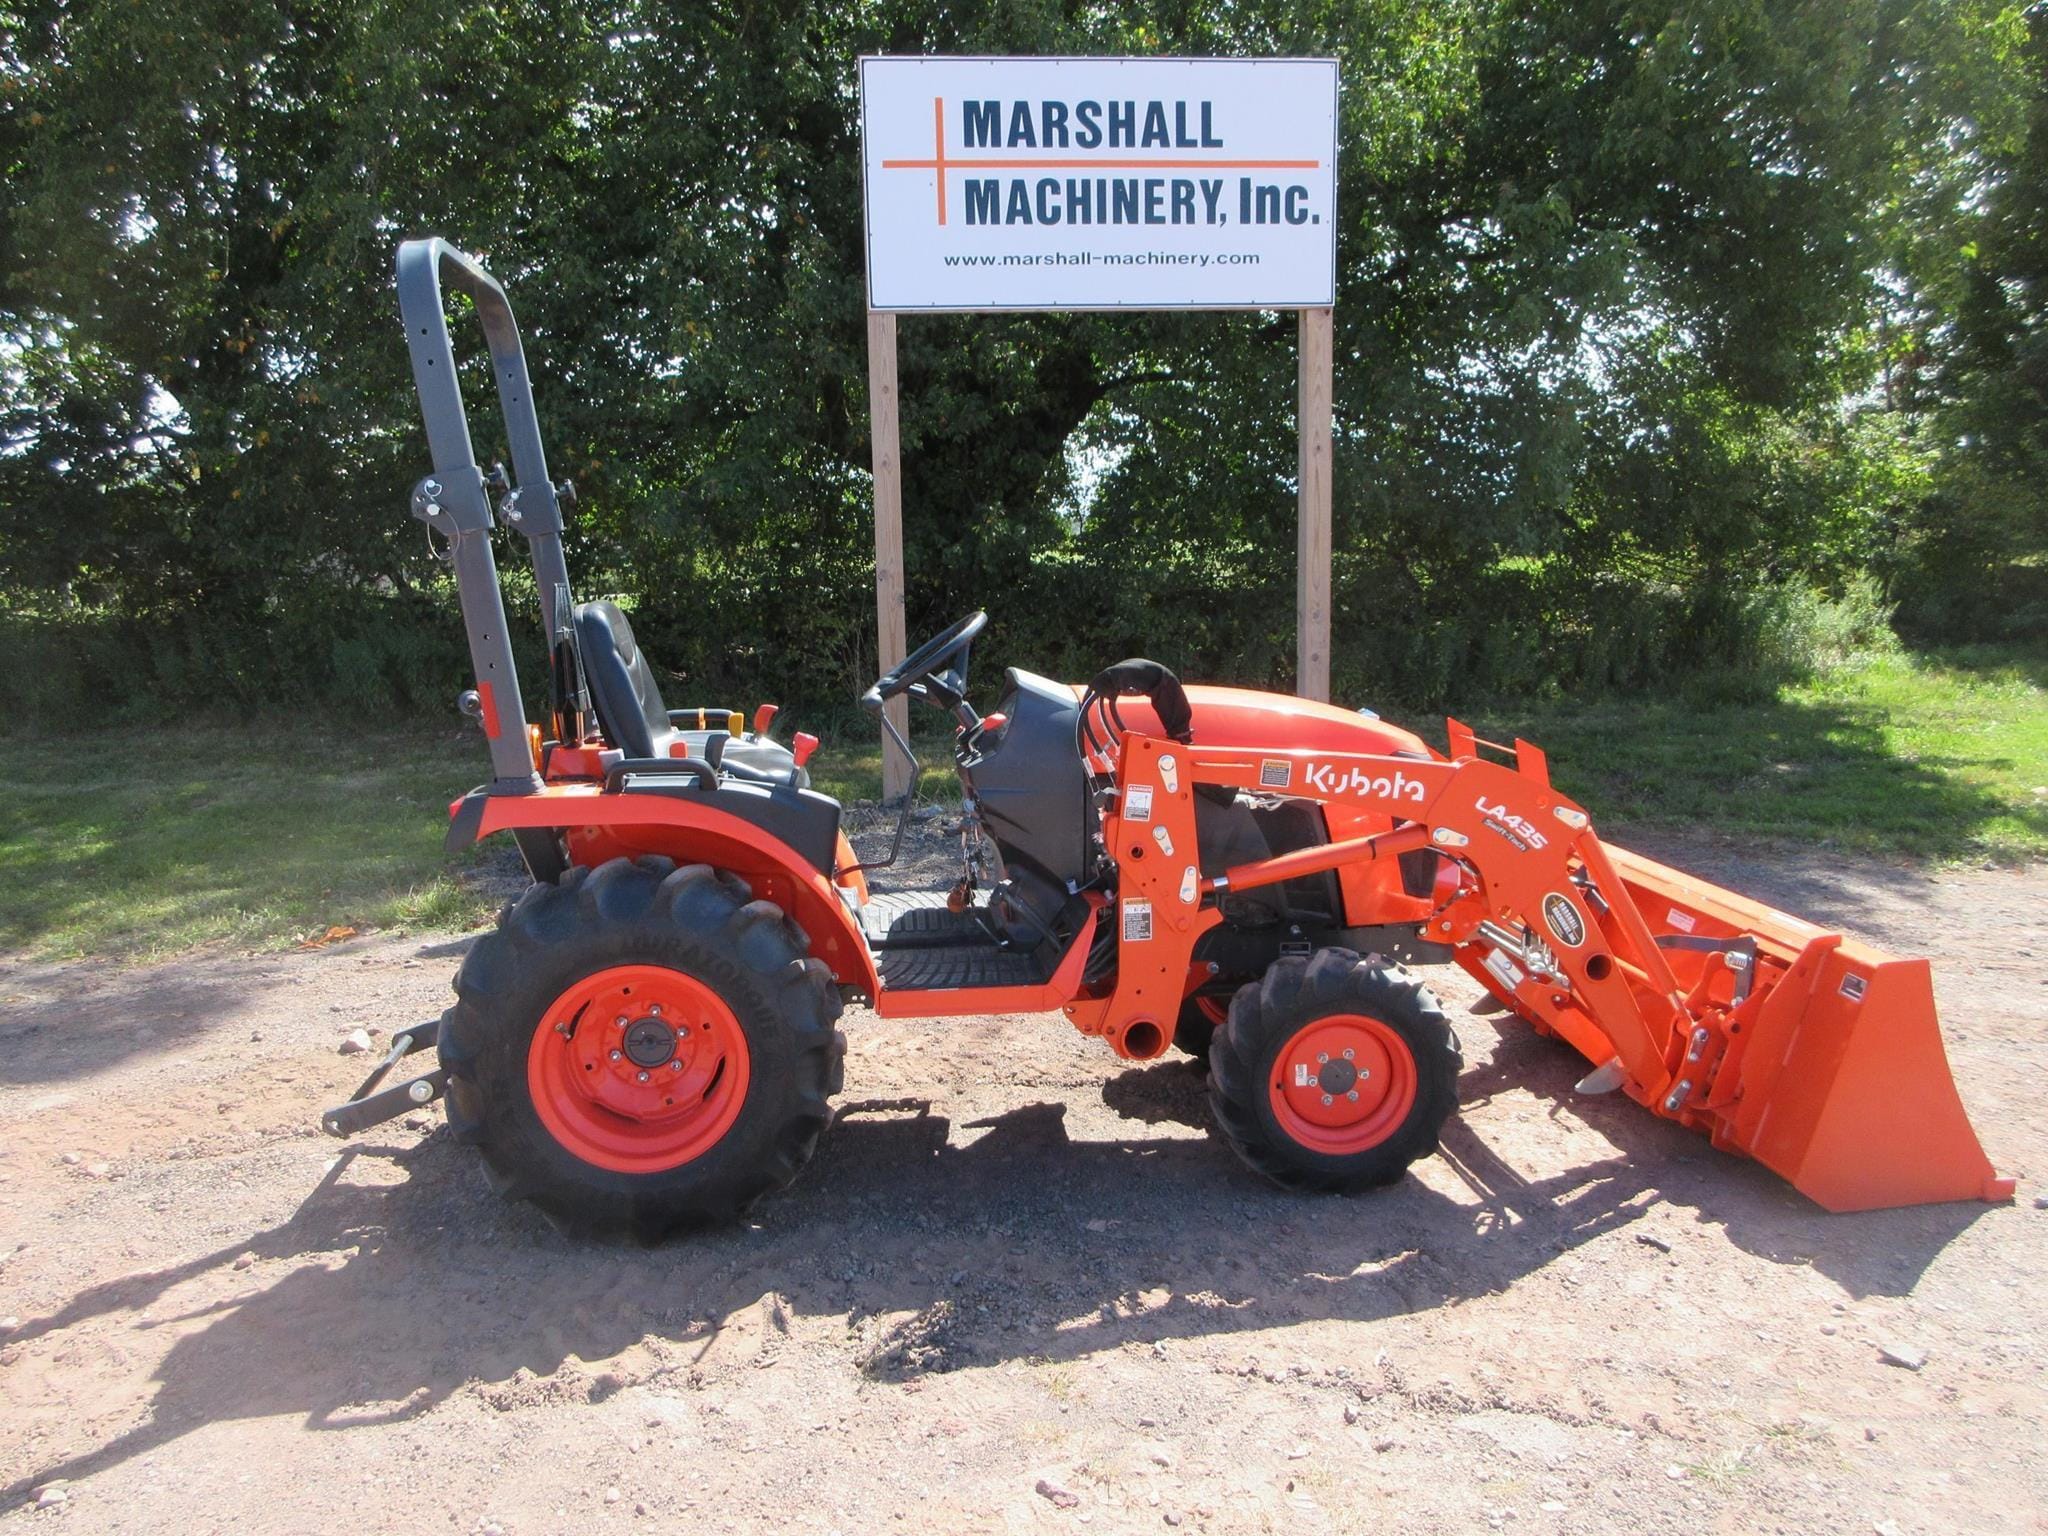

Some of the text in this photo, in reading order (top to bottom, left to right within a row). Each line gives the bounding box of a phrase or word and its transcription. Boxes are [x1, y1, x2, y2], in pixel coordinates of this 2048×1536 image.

[962, 100, 1224, 149] MARSHALL
[964, 177, 1320, 228] MACHINERY, Inc.
[944, 251, 1260, 266] www.marshall-machinery.com
[1305, 763, 1425, 801] Kubota
[1475, 796, 1548, 849] LA435
